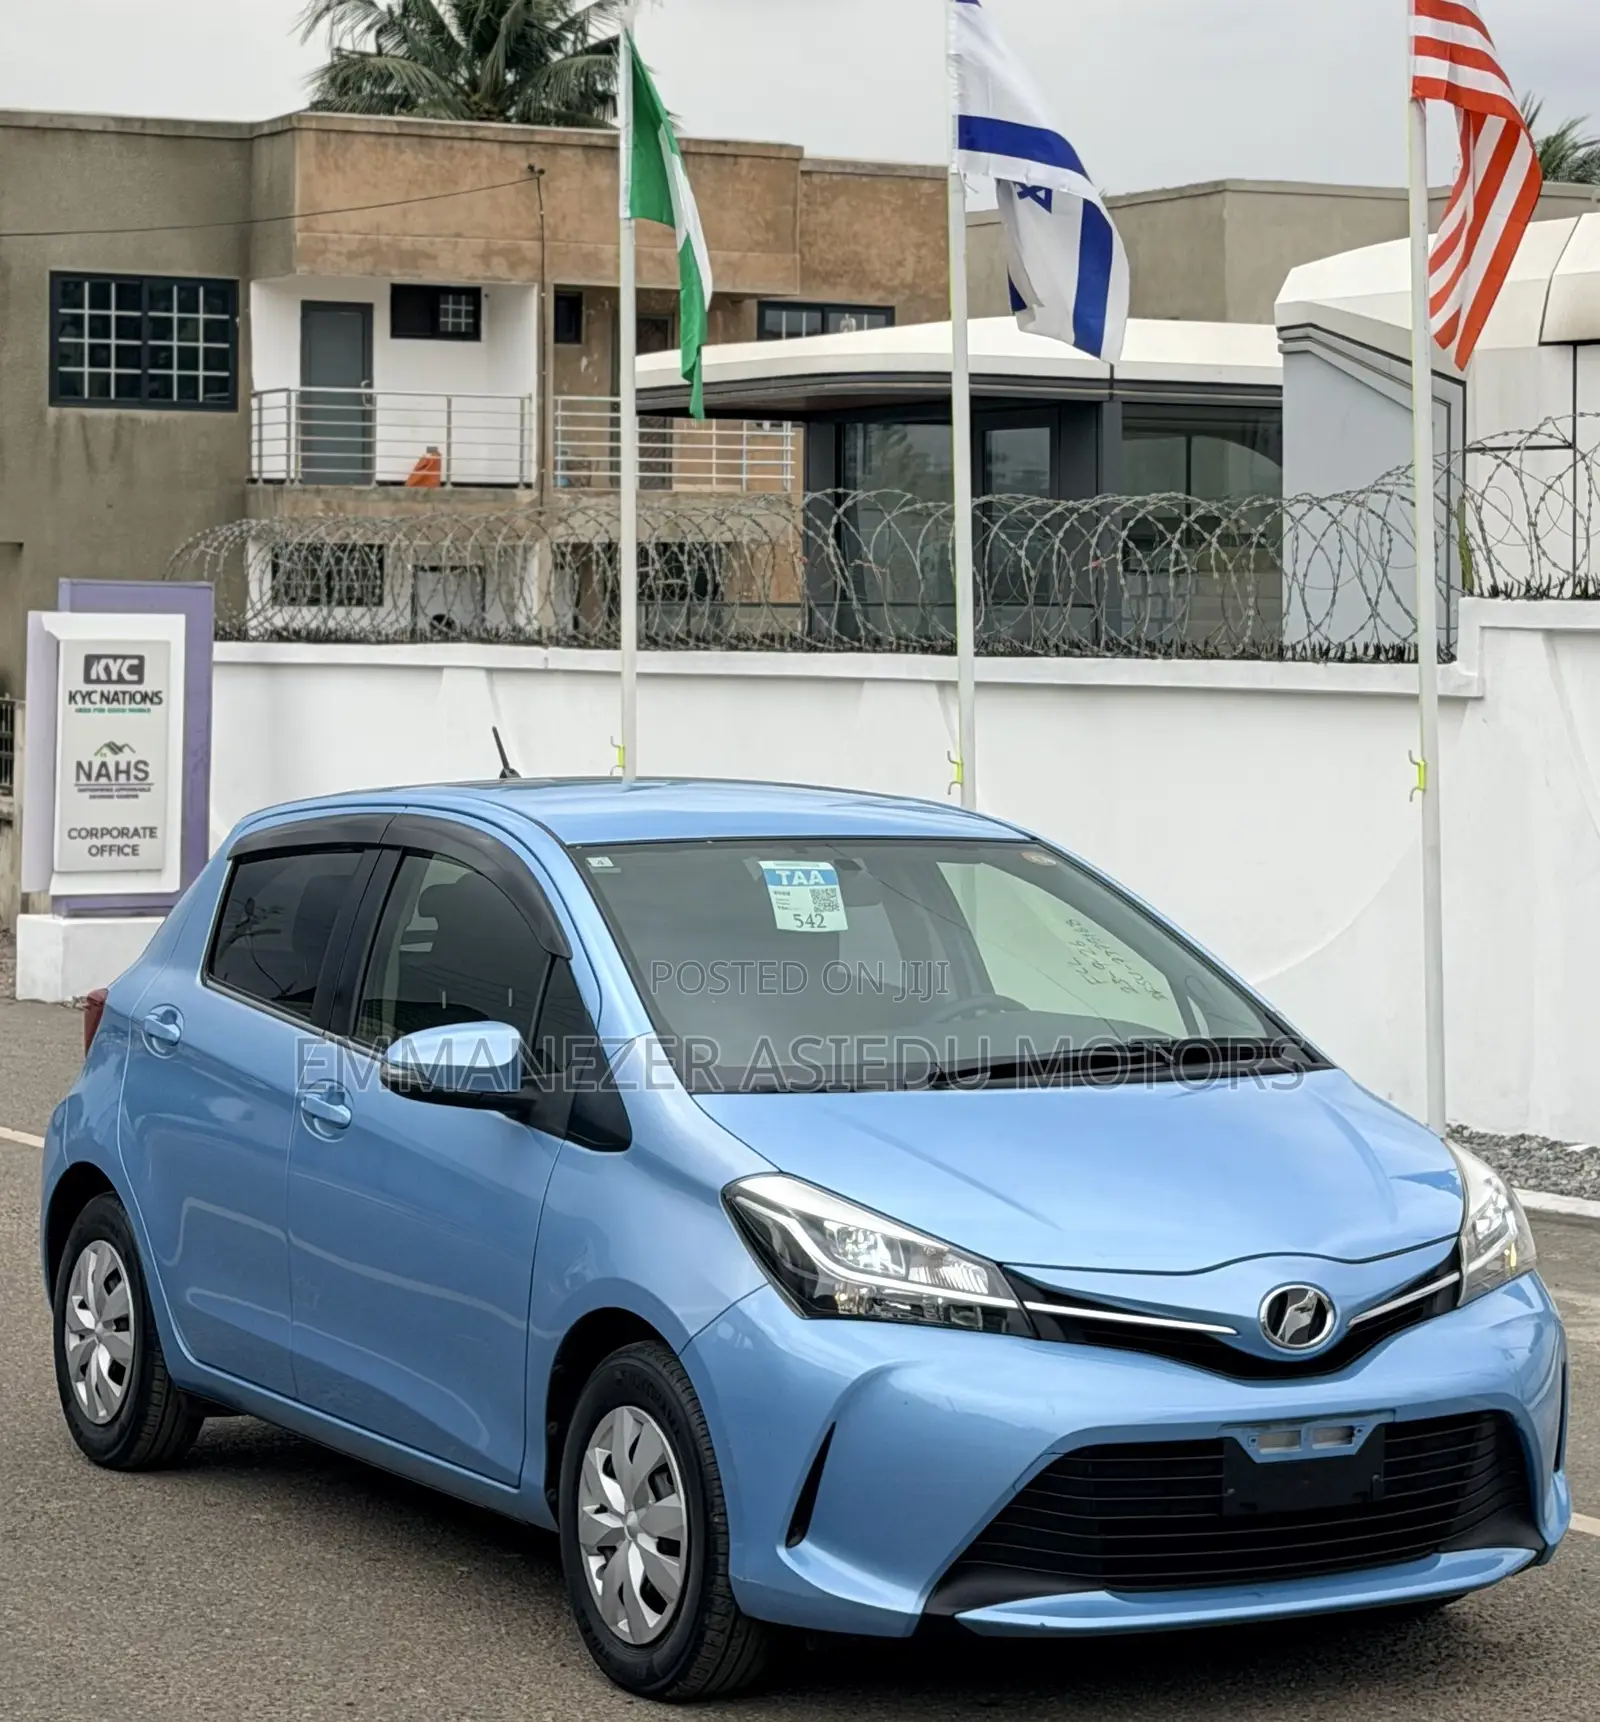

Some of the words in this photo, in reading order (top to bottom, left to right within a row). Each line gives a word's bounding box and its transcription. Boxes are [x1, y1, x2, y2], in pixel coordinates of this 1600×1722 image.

[90, 658, 140, 681] KYC
[68, 689, 98, 705] KYC
[99, 689, 163, 706] NATIONS
[75, 760, 150, 782] NAHS
[67, 826, 158, 840] CORPORATE
[88, 844, 140, 857] OFFICE
[775, 870, 826, 885] TAA
[793, 913, 827, 929] 542
